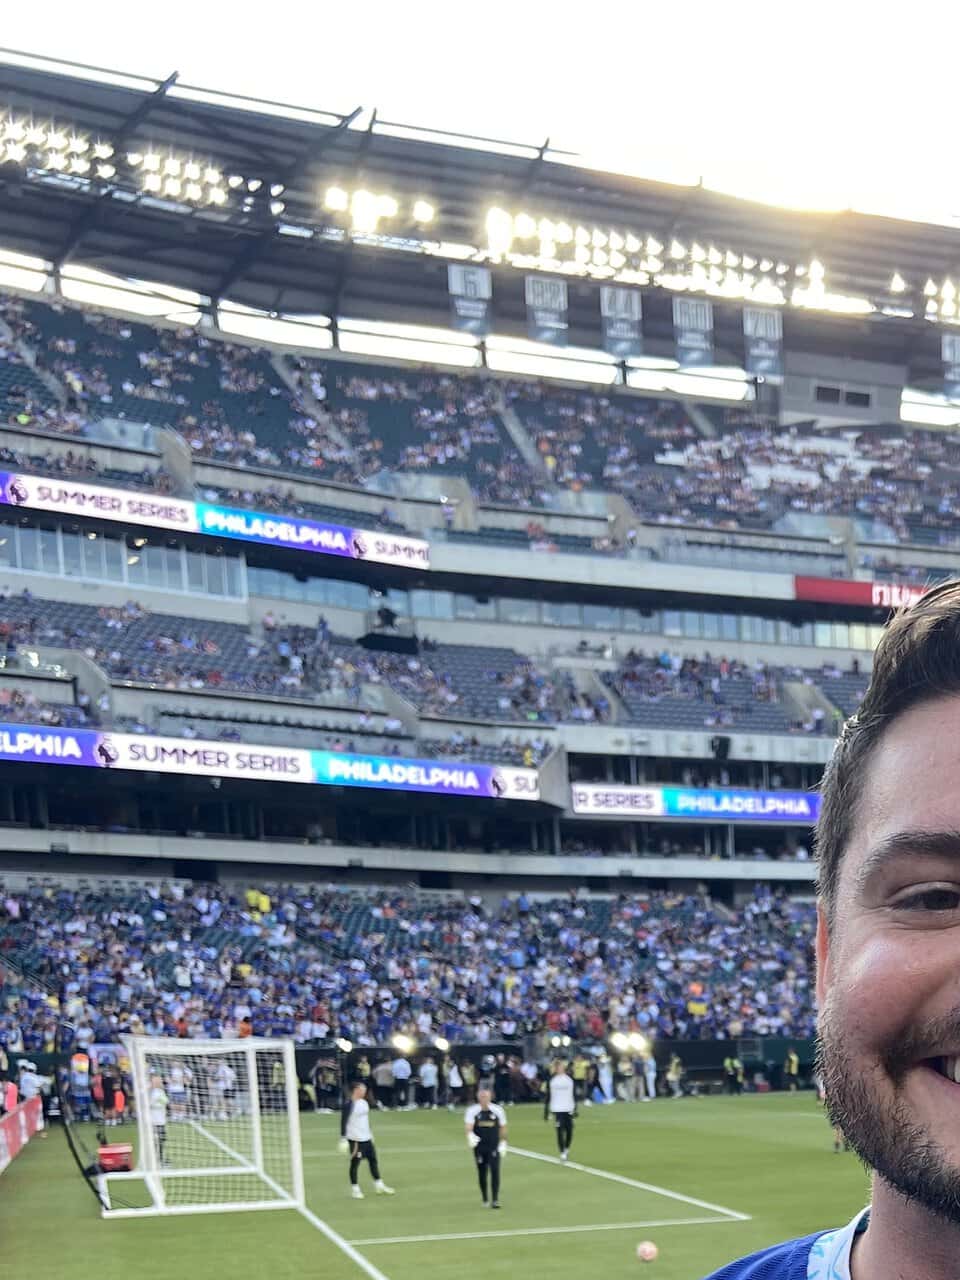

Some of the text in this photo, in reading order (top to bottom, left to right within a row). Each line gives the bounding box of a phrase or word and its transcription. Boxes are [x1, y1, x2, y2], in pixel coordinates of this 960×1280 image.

[37, 486, 189, 523] SUMMER SERIES
[205, 511, 347, 549] PHILADELPHIA
[129, 743, 229, 768] SUMMER
[329, 758, 479, 789] PHILADELPHIA
[592, 792, 655, 810] SERIES
[677, 795, 811, 815] PHILADELPHIA
